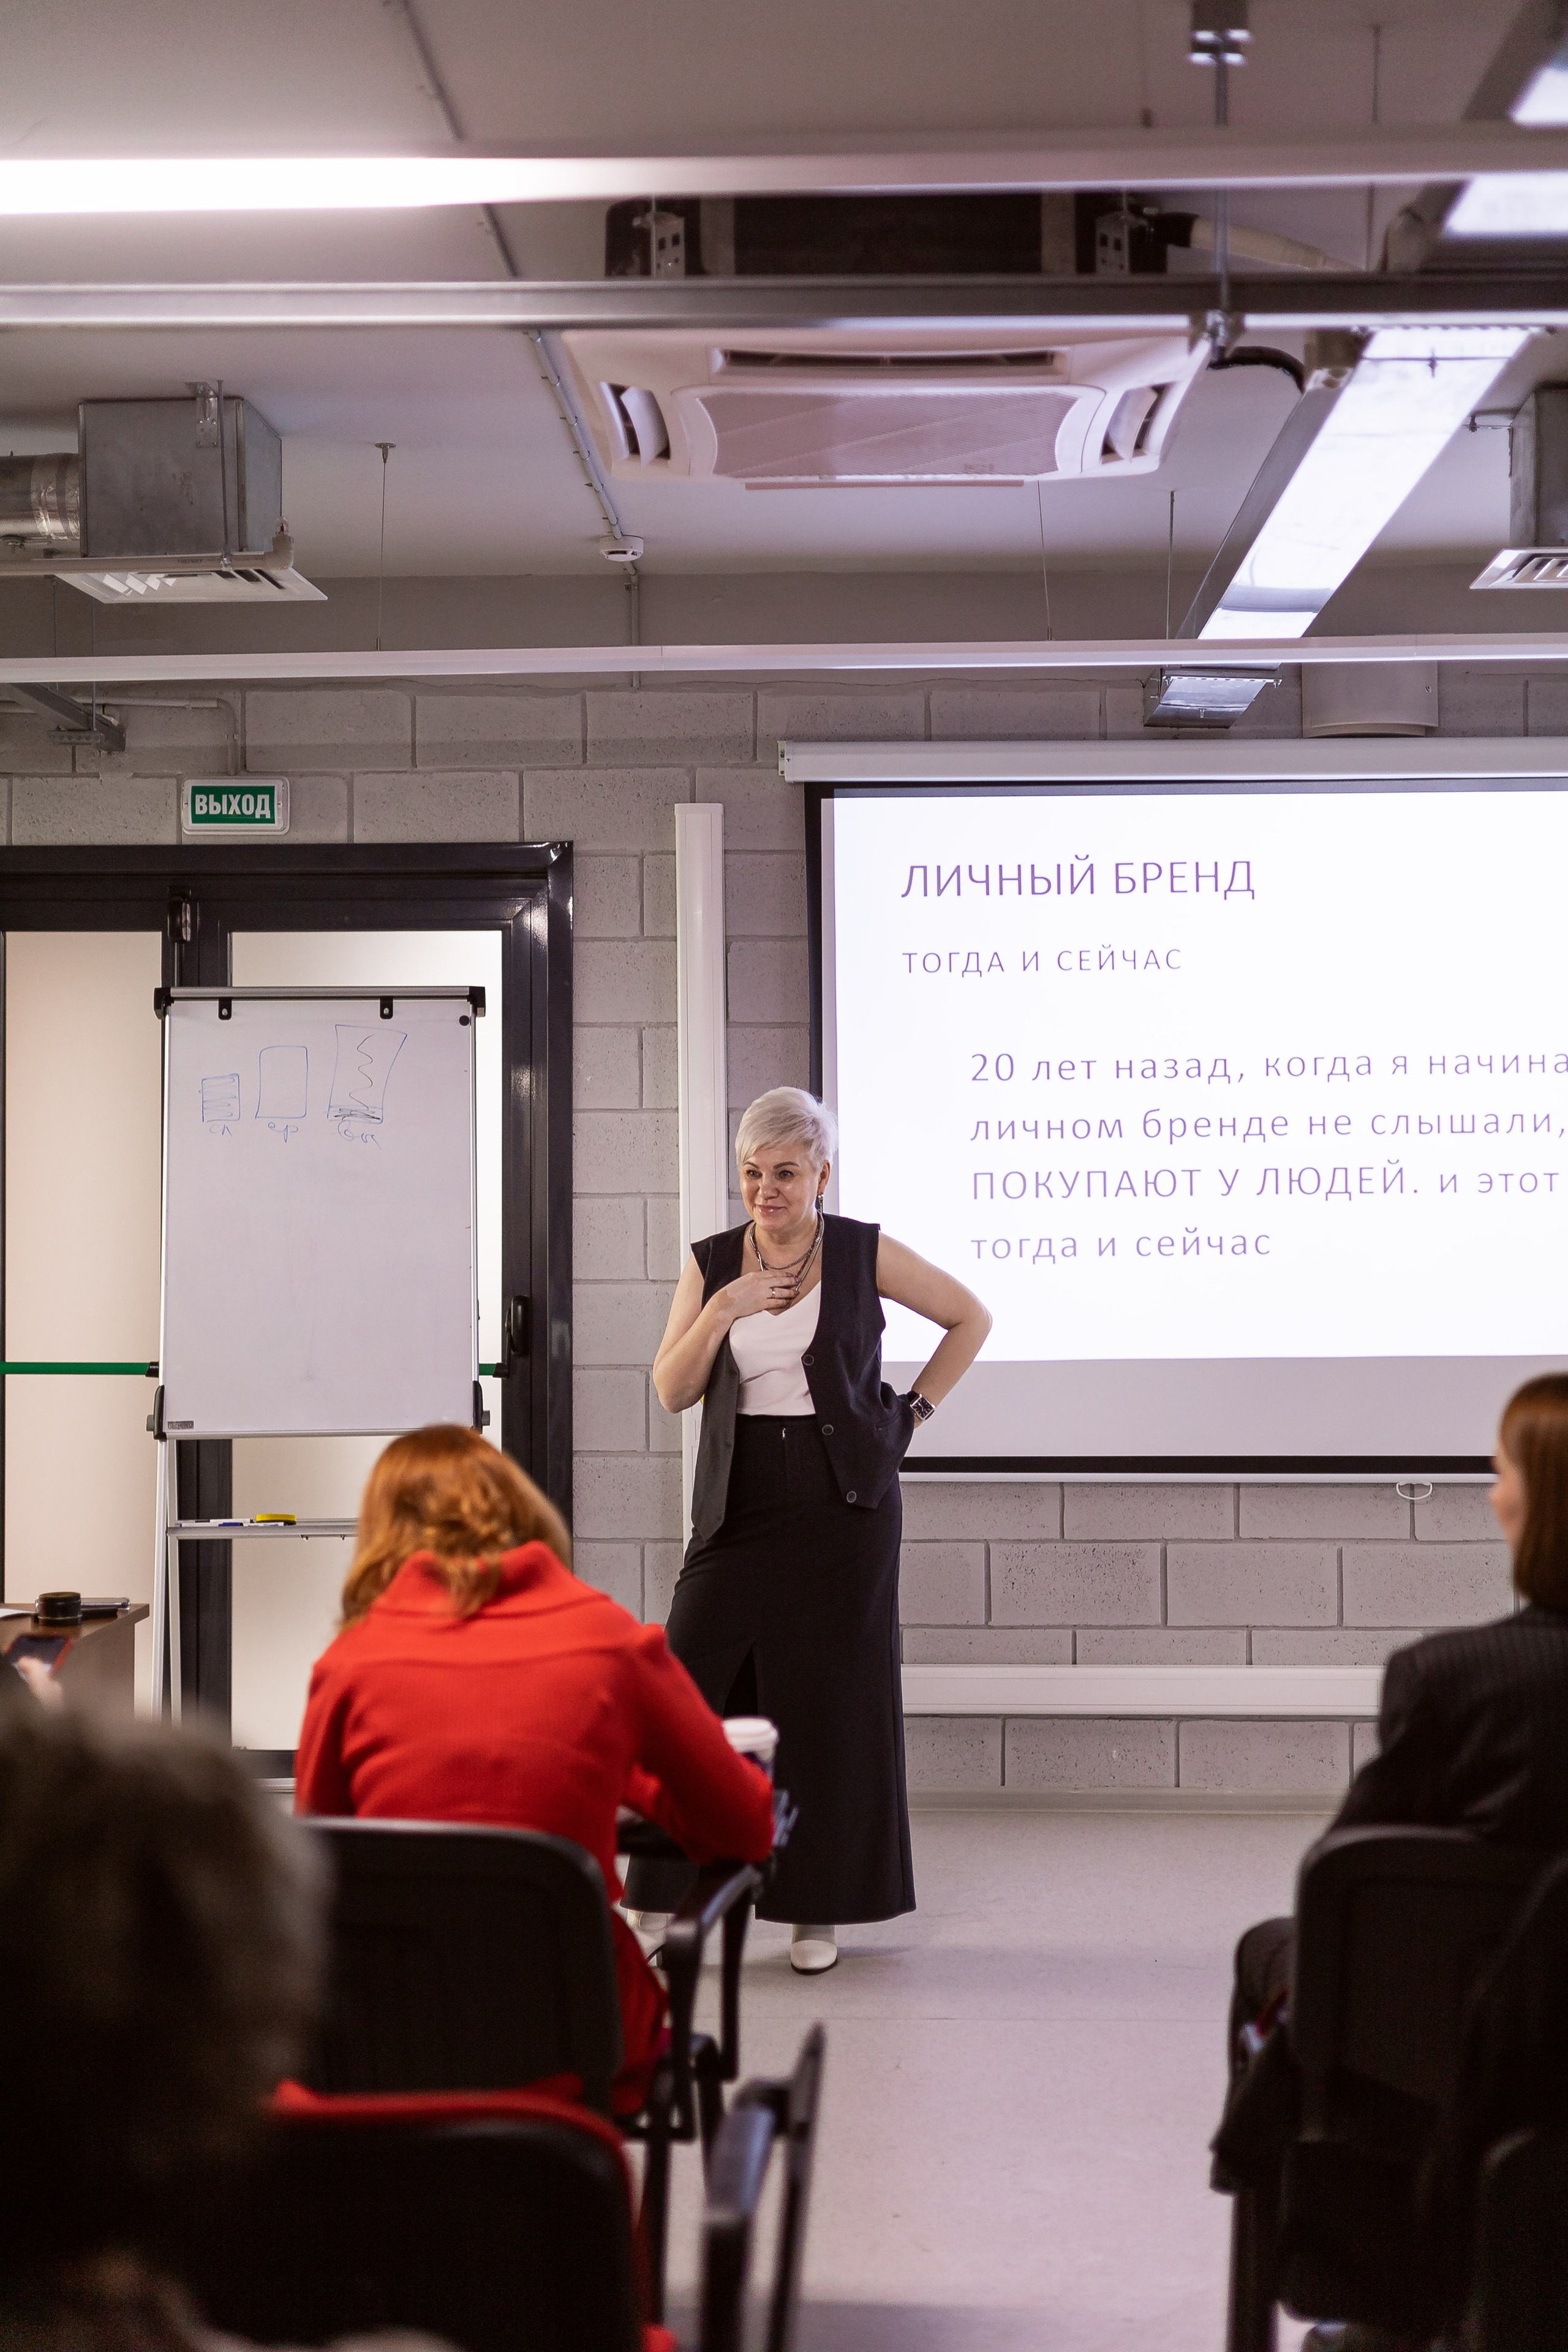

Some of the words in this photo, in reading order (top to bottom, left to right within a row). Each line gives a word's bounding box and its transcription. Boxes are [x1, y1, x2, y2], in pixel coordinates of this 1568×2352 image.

[195, 794, 271, 818] ВЫХОД
[901, 854, 1095, 898] ЛИЧНЫЙ
[1115, 861, 1255, 901] БРЕНД
[902, 951, 1005, 978] ТОГДА
[1022, 951, 1039, 972] И
[1057, 944, 1181, 971] СЕЙЧАС
[971, 1053, 1014, 1082] 20
[1031, 1060, 1097, 1081] лет
[1115, 1058, 1244, 1085] назад,
[1265, 1055, 1371, 1083] когда
[1392, 1055, 1407, 1075] я
[1429, 1054, 1568, 1075] начина
[970, 1118, 1123, 1141] личном
[1143, 1108, 1288, 1145] бренде
[1309, 1115, 1351, 1136] не
[1371, 1114, 1565, 1138] слышали,
[973, 1169, 1202, 1200] ПОКУПАЮТ
[1218, 1169, 1239, 1197] У
[1256, 1159, 1418, 1202] ЛЮДЕЙ.
[1440, 1174, 1457, 1193] и
[1477, 1172, 1559, 1194] этот
[970, 1237, 1077, 1265] тогда
[1098, 1237, 1115, 1257] и
[1136, 1227, 1270, 1257] сейчас
